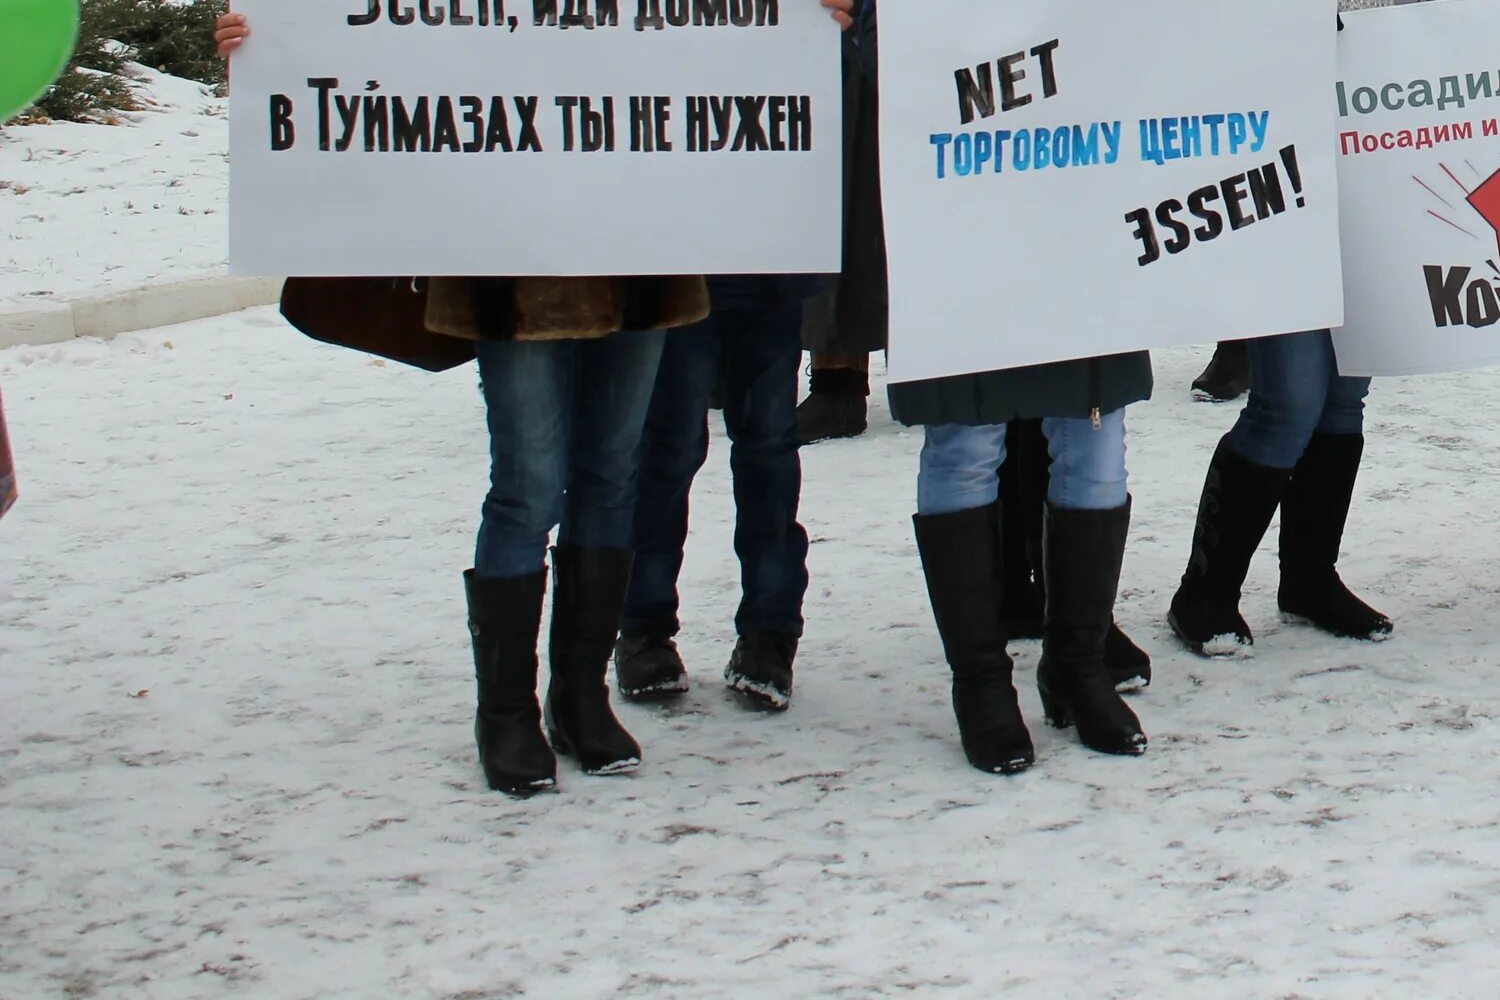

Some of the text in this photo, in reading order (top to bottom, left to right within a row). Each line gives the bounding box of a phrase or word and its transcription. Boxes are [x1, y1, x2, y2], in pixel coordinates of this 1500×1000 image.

[929, 110, 1270, 179] ТОРГОВОМУ ЦЕНТРУ
[1340, 123, 1473, 156] Посадим
[1483, 119, 1498, 136] и
